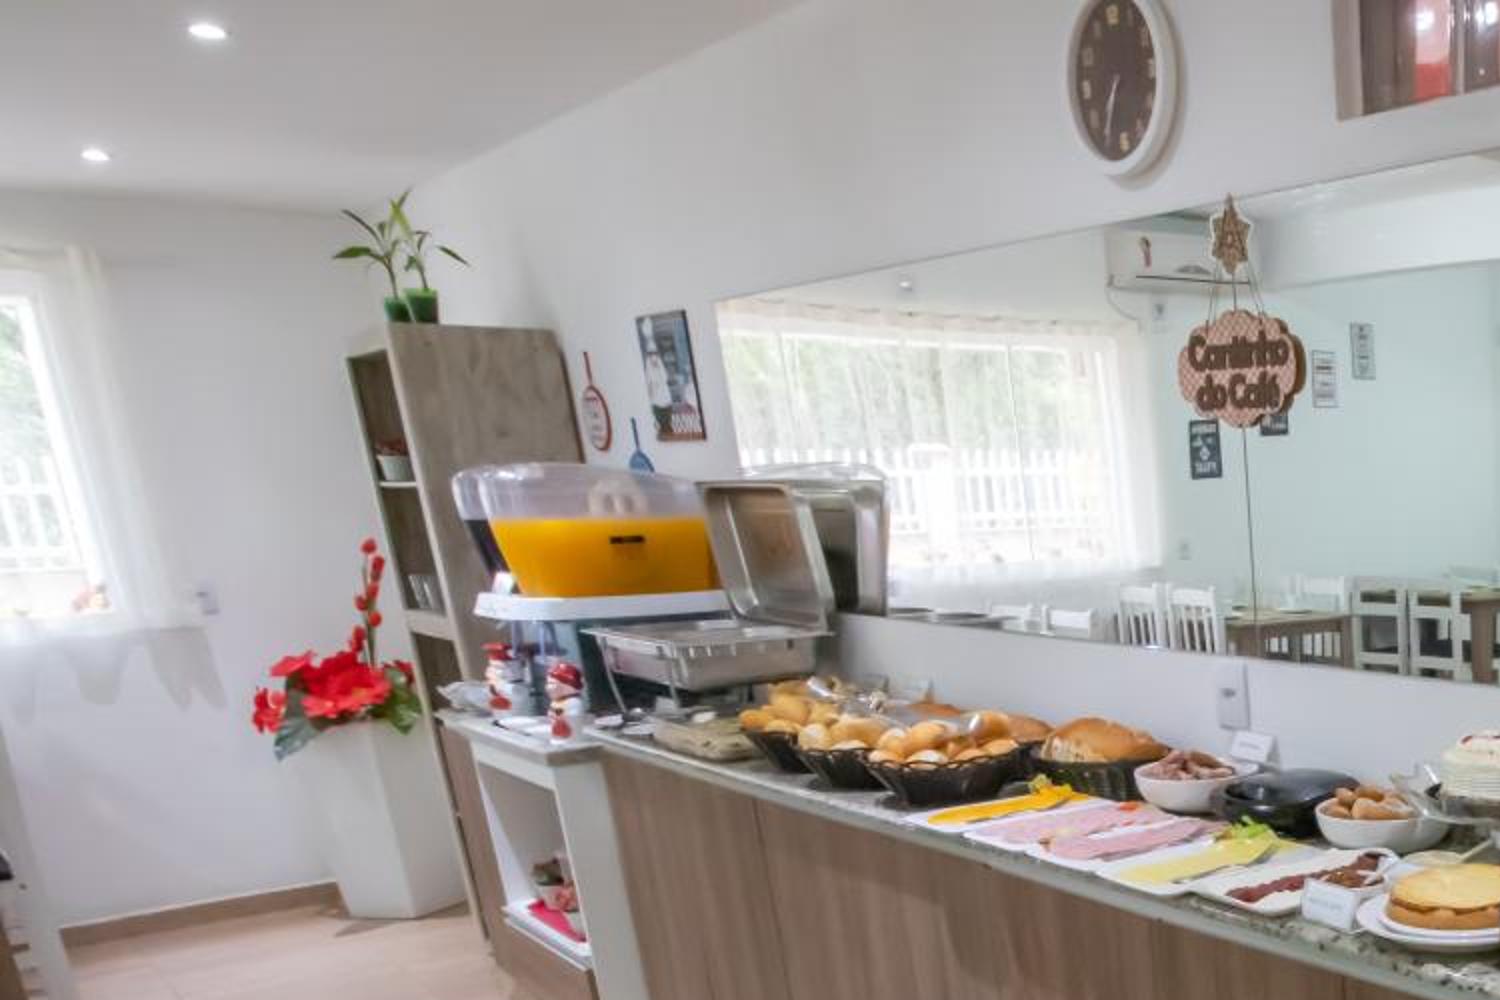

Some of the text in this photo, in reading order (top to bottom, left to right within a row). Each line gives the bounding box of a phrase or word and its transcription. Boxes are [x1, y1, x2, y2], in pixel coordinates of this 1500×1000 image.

[1188, 330, 1289, 371] Cantinho
[1196, 371, 1280, 411] do Café
